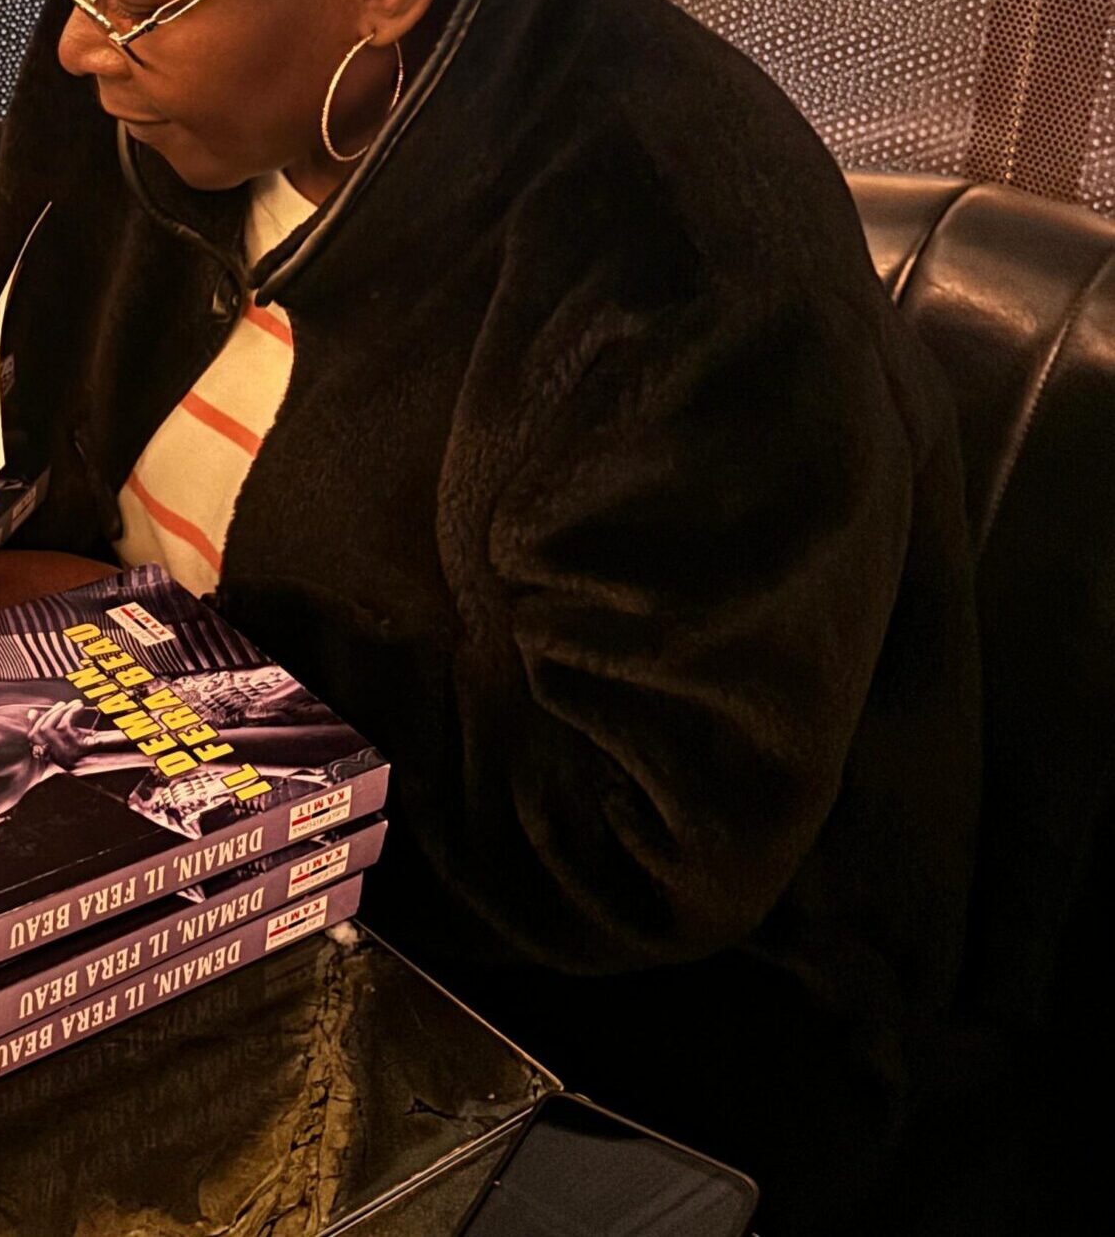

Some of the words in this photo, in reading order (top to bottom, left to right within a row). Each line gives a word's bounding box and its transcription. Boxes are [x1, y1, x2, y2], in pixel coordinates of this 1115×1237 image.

[131, 606, 167, 636] KAMIT
[63, 623, 155, 688] BEAU
[65, 659, 199, 778] DEMAIN,
[141, 687, 234, 762] FERA
[221, 763, 273, 801] IL
[297, 790, 345, 818] KAMIT
[173, 826, 264, 882] DEMAIN,
[295, 848, 343, 876] KAMIT
[144, 868, 165, 895] IL
[78, 882, 136, 921] FERA
[177, 887, 265, 944] DEMAIN,
[275, 900, 321, 928] KAMIT
[9, 902, 71, 949] BEAU
[149, 930, 169, 958] IL
[85, 947, 141, 987] FERA
[153, 940, 242, 996] DEMAIN,
[19, 972, 79, 1018] BEAU
[125, 982, 145, 1010] IL
[61, 1002, 117, 1041] FERA
